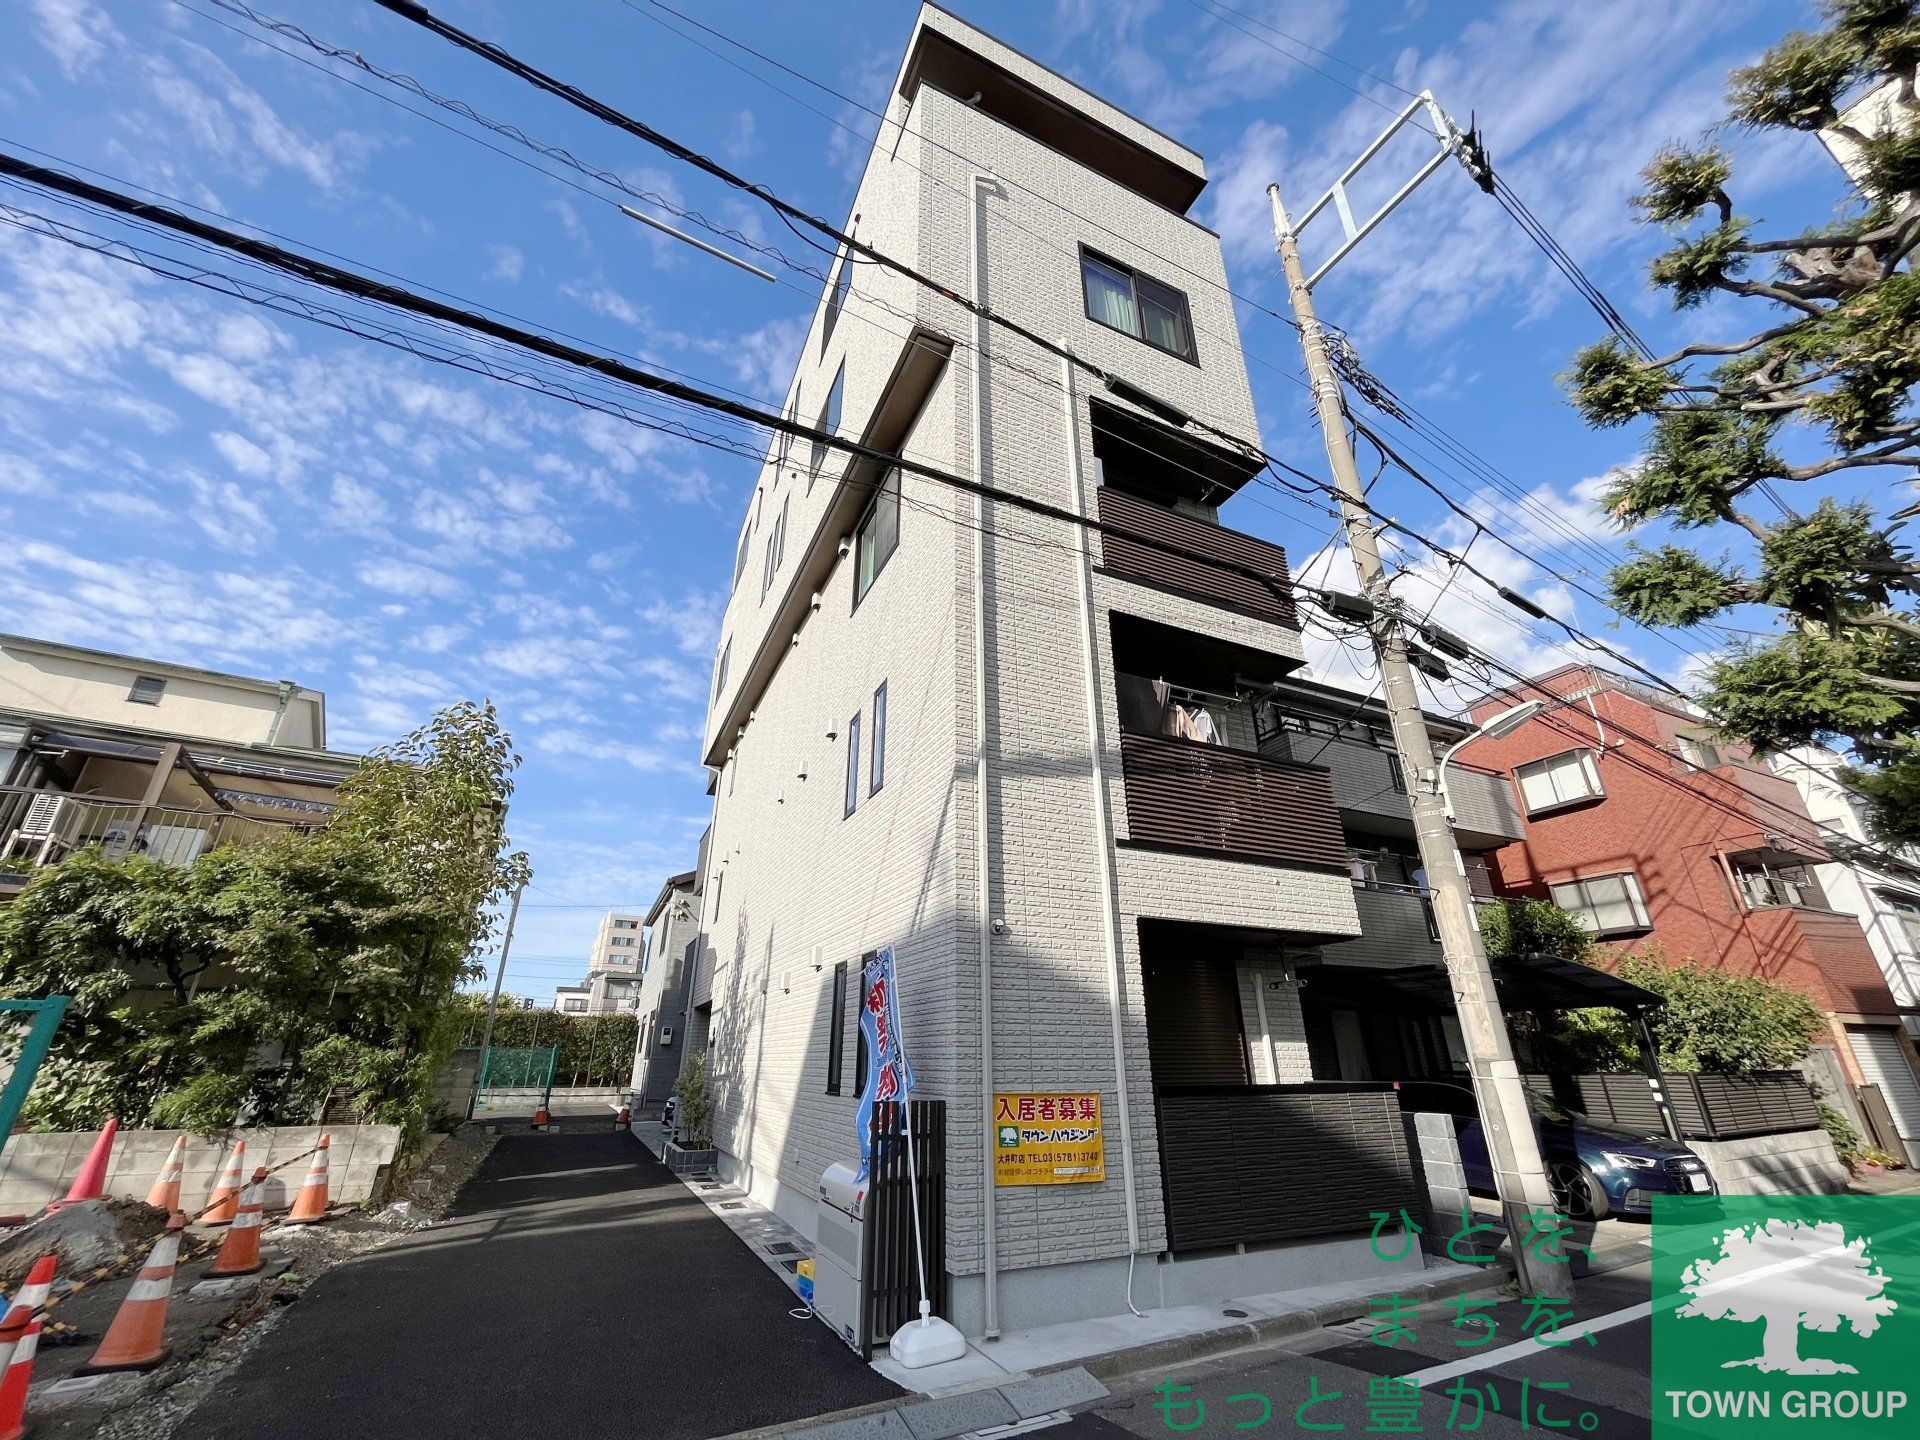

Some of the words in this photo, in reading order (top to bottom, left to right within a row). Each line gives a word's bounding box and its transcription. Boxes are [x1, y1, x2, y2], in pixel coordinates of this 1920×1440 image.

[996, 1097, 1096, 1121] 入居者募集
[1021, 1128, 1098, 1143] タウンハウジング
[997, 1154, 1025, 1164] 大井町店
